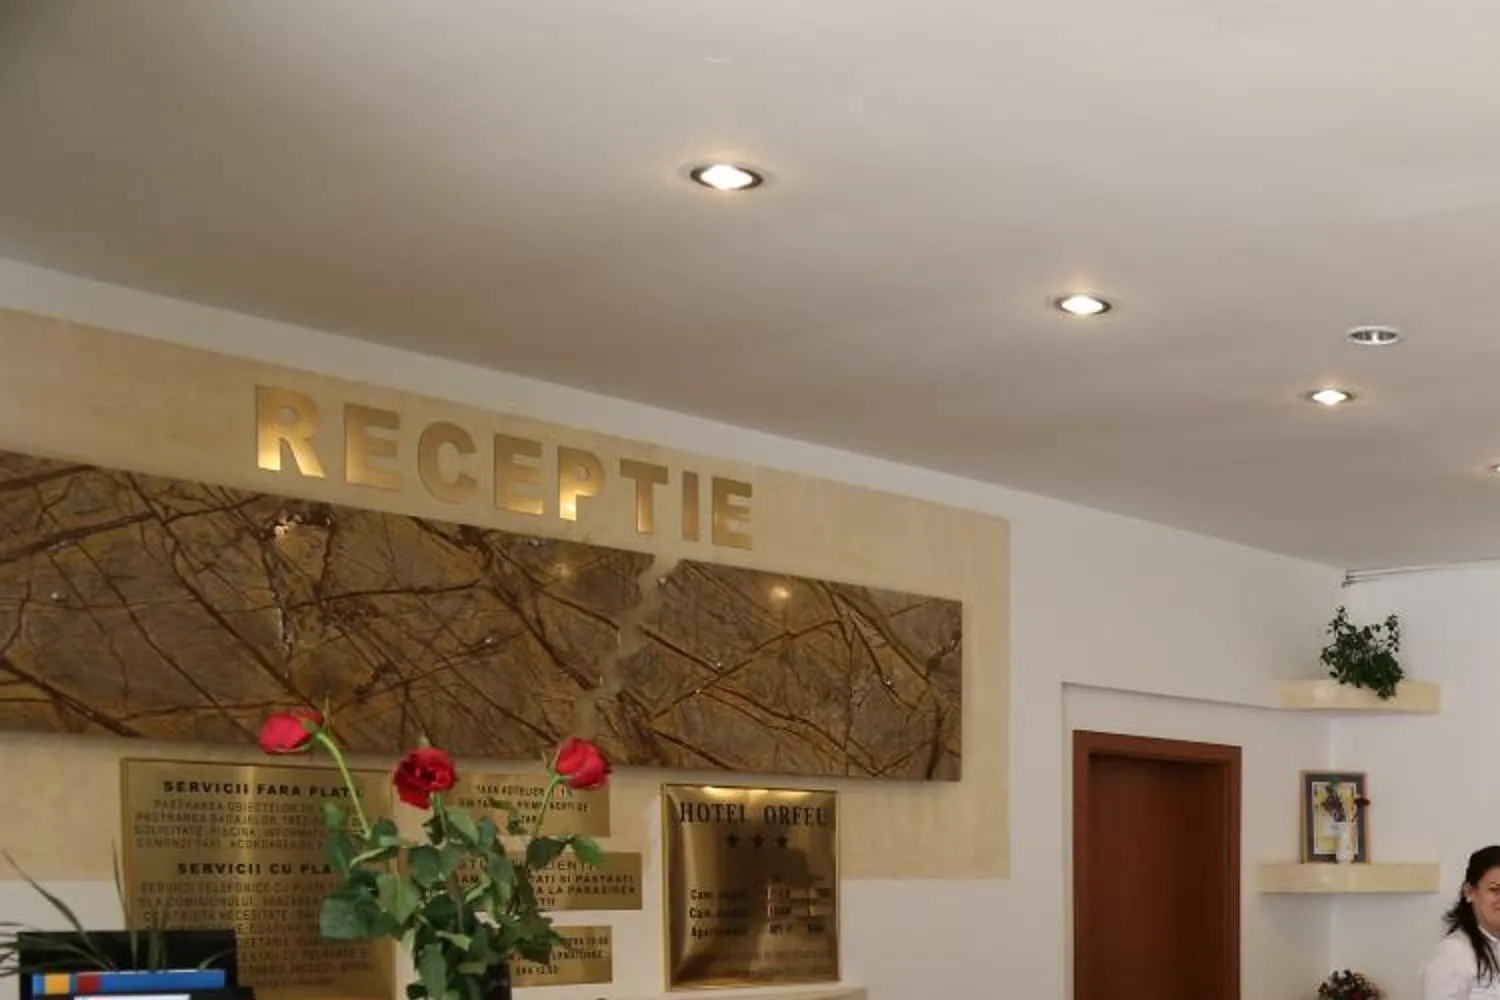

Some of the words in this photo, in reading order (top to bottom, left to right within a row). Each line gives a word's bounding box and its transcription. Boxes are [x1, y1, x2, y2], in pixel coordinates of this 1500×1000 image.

[255, 384, 753, 551] RECEPTIE
[163, 780, 249, 795] SERVICII
[256, 783, 301, 796] FARA
[679, 801, 746, 824] HOTEL
[763, 805, 829, 827] ORFEU
[177, 863, 261, 875] SERVICII
[269, 864, 292, 876] CU
[300, 864, 331, 876] PLA
